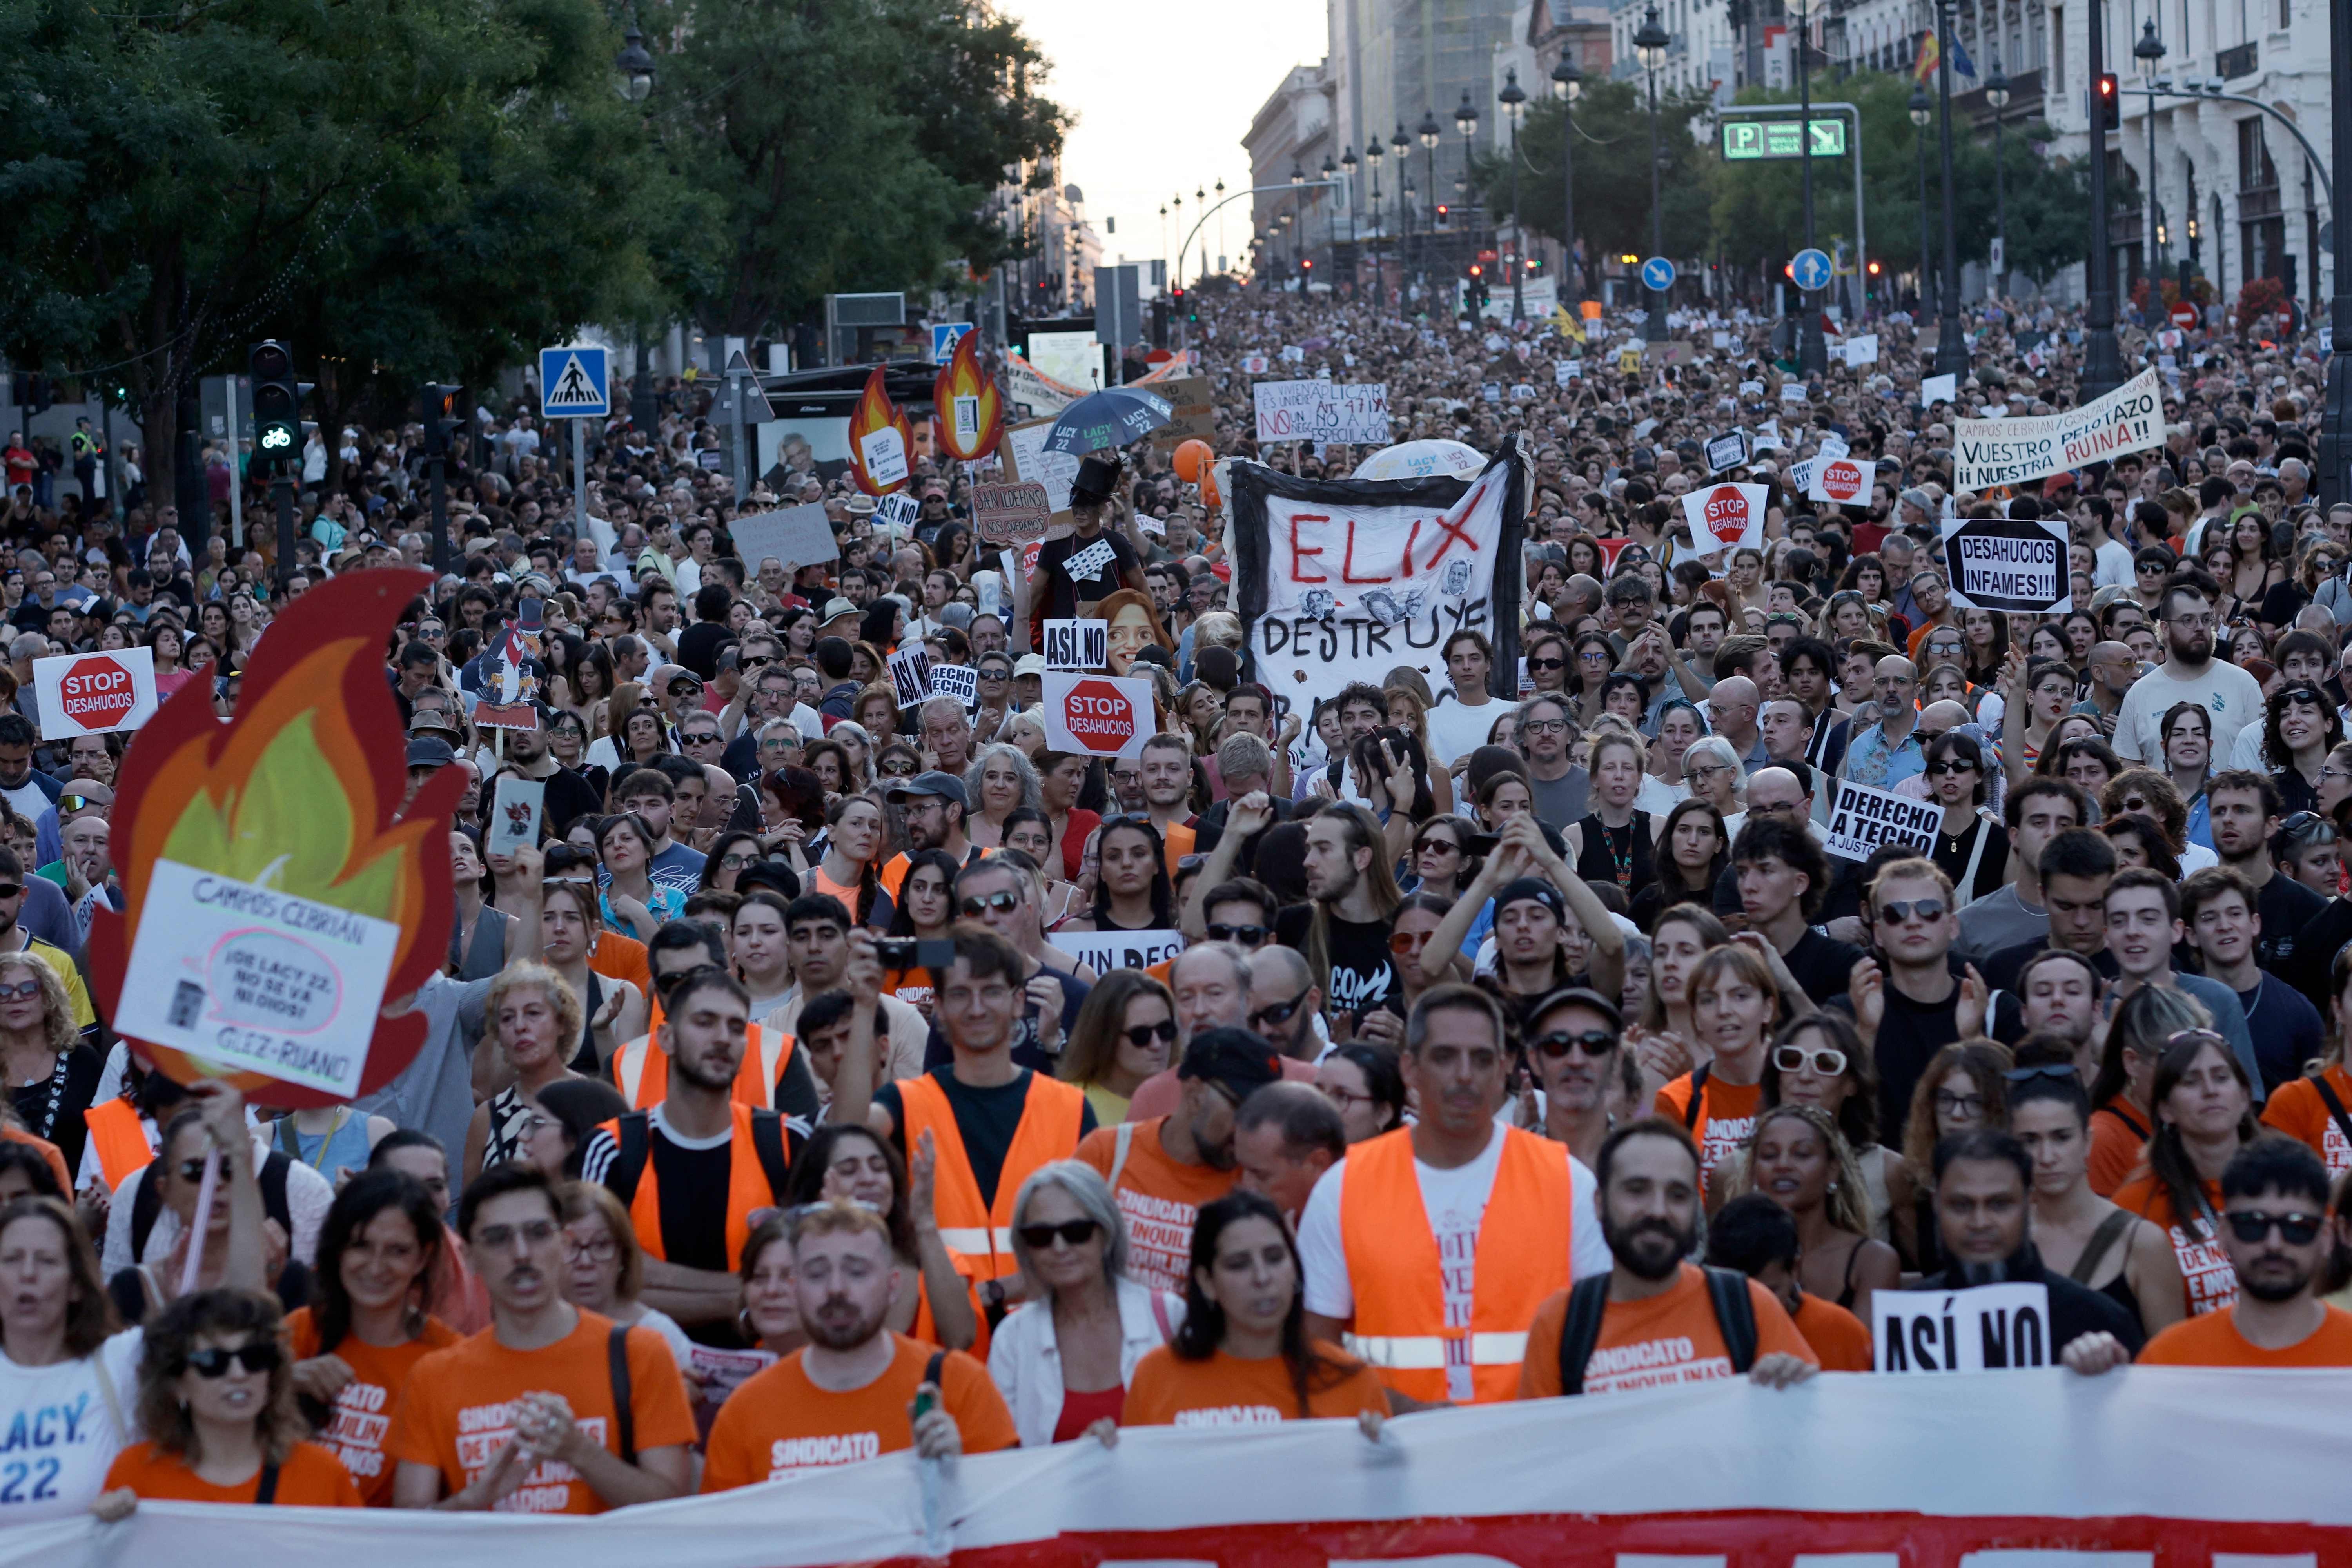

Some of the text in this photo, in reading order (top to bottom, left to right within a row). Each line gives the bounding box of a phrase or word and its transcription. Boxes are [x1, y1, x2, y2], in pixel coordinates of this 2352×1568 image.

[1135, 420, 1154, 434] 22
[1260, 409, 1291, 436] NO
[1317, 412, 1388, 427] NO A LA
[1958, 423, 2002, 437] CAMPOS
[1962, 394, 2154, 463] VUESTRO PELOTAZO
[1055, 439, 1069, 450] 22
[1091, 436, 1109, 450] 22
[1312, 425, 1390, 442] ESPECULACIÓN
[1826, 469, 1859, 482] STOP
[1978, 455, 2054, 486] NUESTRA
[1824, 479, 1860, 493] DESAHUCIOS
[976, 488, 1048, 511] SAN ILDEFONSO
[1708, 499, 1745, 517] STOP
[897, 502, 916, 525] NO
[1711, 514, 1746, 533] DESAHUCIOS
[987, 517, 1044, 534] NOS QUEDAMOS
[1290, 484, 1486, 584] ELIX
[1023, 551, 1040, 567] STO
[1963, 538, 2054, 564] DESAHUCIOS
[1966, 568, 2055, 596] INFAMES!!!
[1263, 597, 1487, 662] DESTRUYE
[1047, 620, 1104, 667] ASÍ, NO
[66, 671, 126, 695] STOP
[911, 651, 933, 697] NO
[932, 679, 973, 697] ECHO
[66, 691, 133, 715] DESAHUCIOS
[1070, 695, 1127, 715] STOP
[1070, 717, 1132, 736] DESAHUCIOS
[1839, 788, 1940, 834] DERECHO
[1827, 835, 1836, 846] A
[1831, 812, 1933, 857] A TECHO
[192, 877, 276, 919] CAMPOS
[259, 958, 304, 980] LACY
[234, 969, 312, 1003] NO SE VA
[235, 987, 254, 1004] NI
[1118, 1187, 1198, 1226] SINDICAT
[1886, 1296, 2042, 1371] ASÍ NO
[0, 1392, 86, 1450] ACY.
[772, 1431, 880, 1468] SINDICATO
